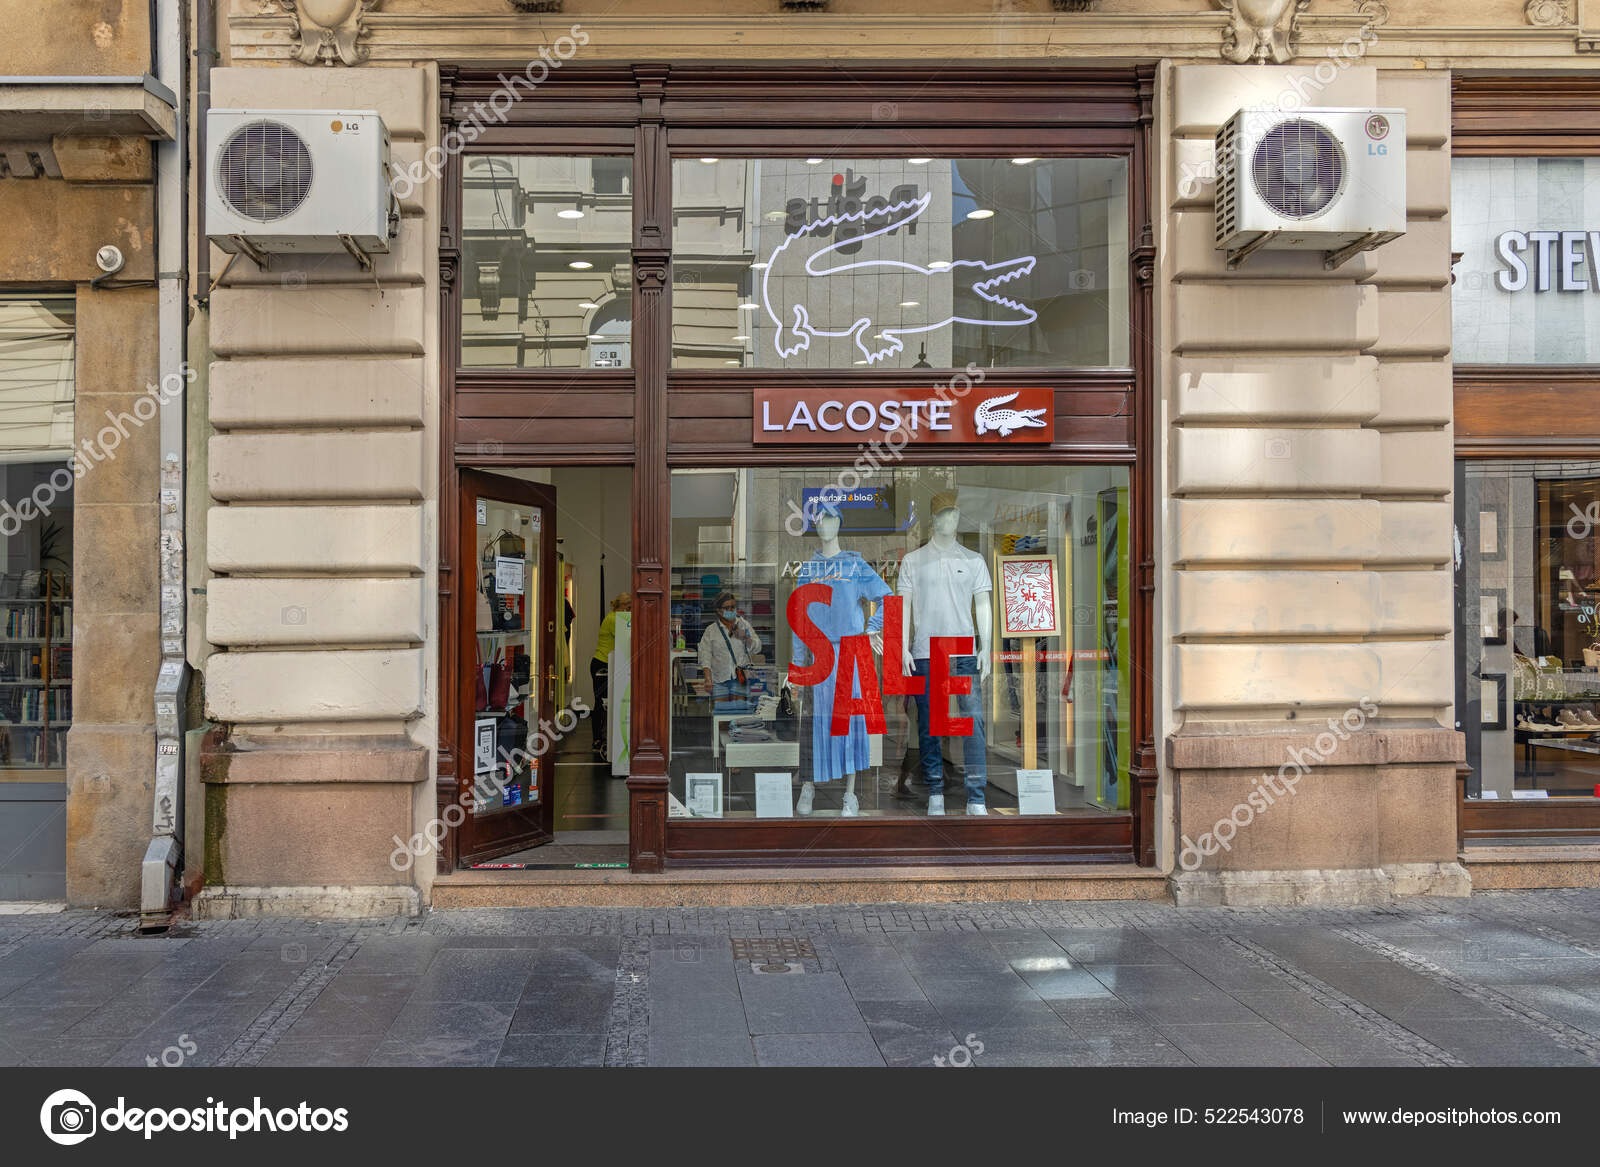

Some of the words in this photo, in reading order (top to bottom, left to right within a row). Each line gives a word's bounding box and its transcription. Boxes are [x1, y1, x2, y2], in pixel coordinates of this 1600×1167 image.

[346, 123, 359, 131] LG
[1368, 144, 1387, 155] LG
[763, 400, 953, 431] LACOSTE
[786, 583, 975, 737] SALE
